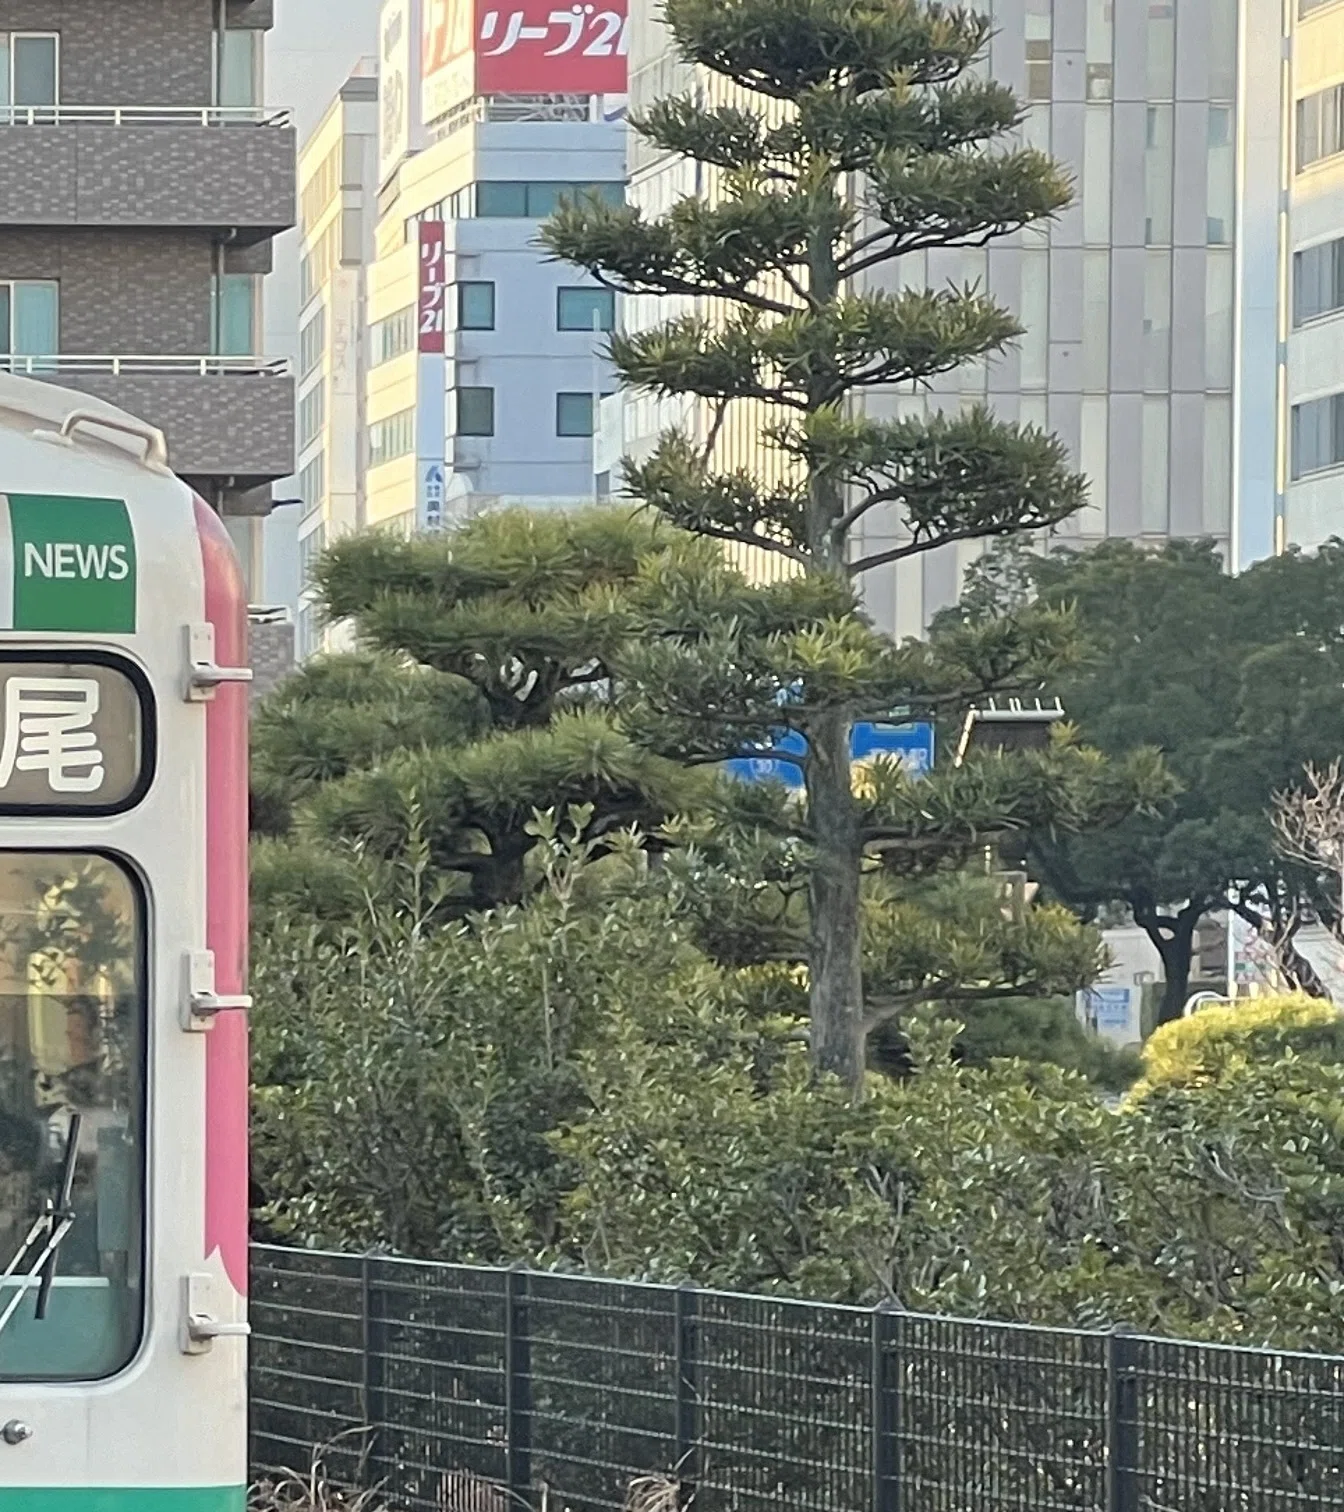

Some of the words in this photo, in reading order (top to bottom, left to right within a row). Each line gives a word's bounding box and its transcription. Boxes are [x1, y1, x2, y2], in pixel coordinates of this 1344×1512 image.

[481, 4, 628, 56] リーブ21
[420, 241, 443, 333] リーブ21
[24, 542, 129, 580] NEWS
